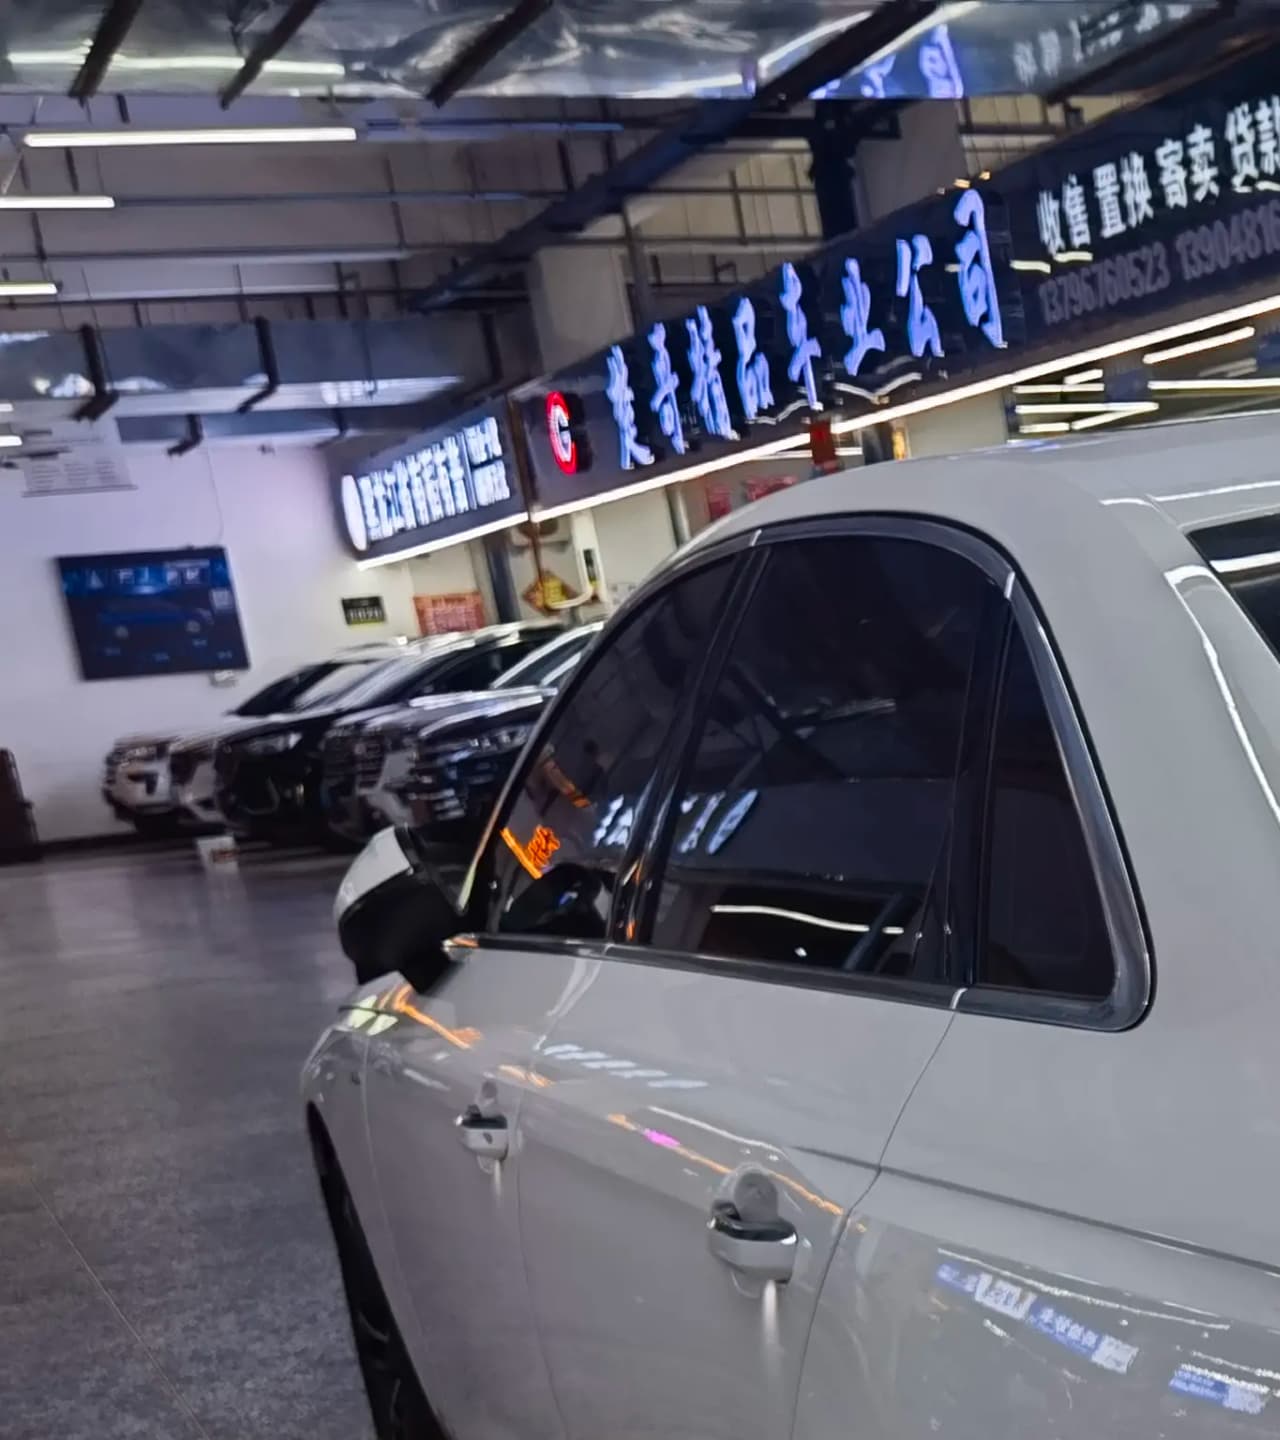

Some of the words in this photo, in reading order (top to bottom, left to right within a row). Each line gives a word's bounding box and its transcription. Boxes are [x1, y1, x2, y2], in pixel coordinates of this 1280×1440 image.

[1036, 171, 1092, 257] 收售
[1093, 150, 1155, 239] 置换
[1155, 123, 1220, 210] 寄卖
